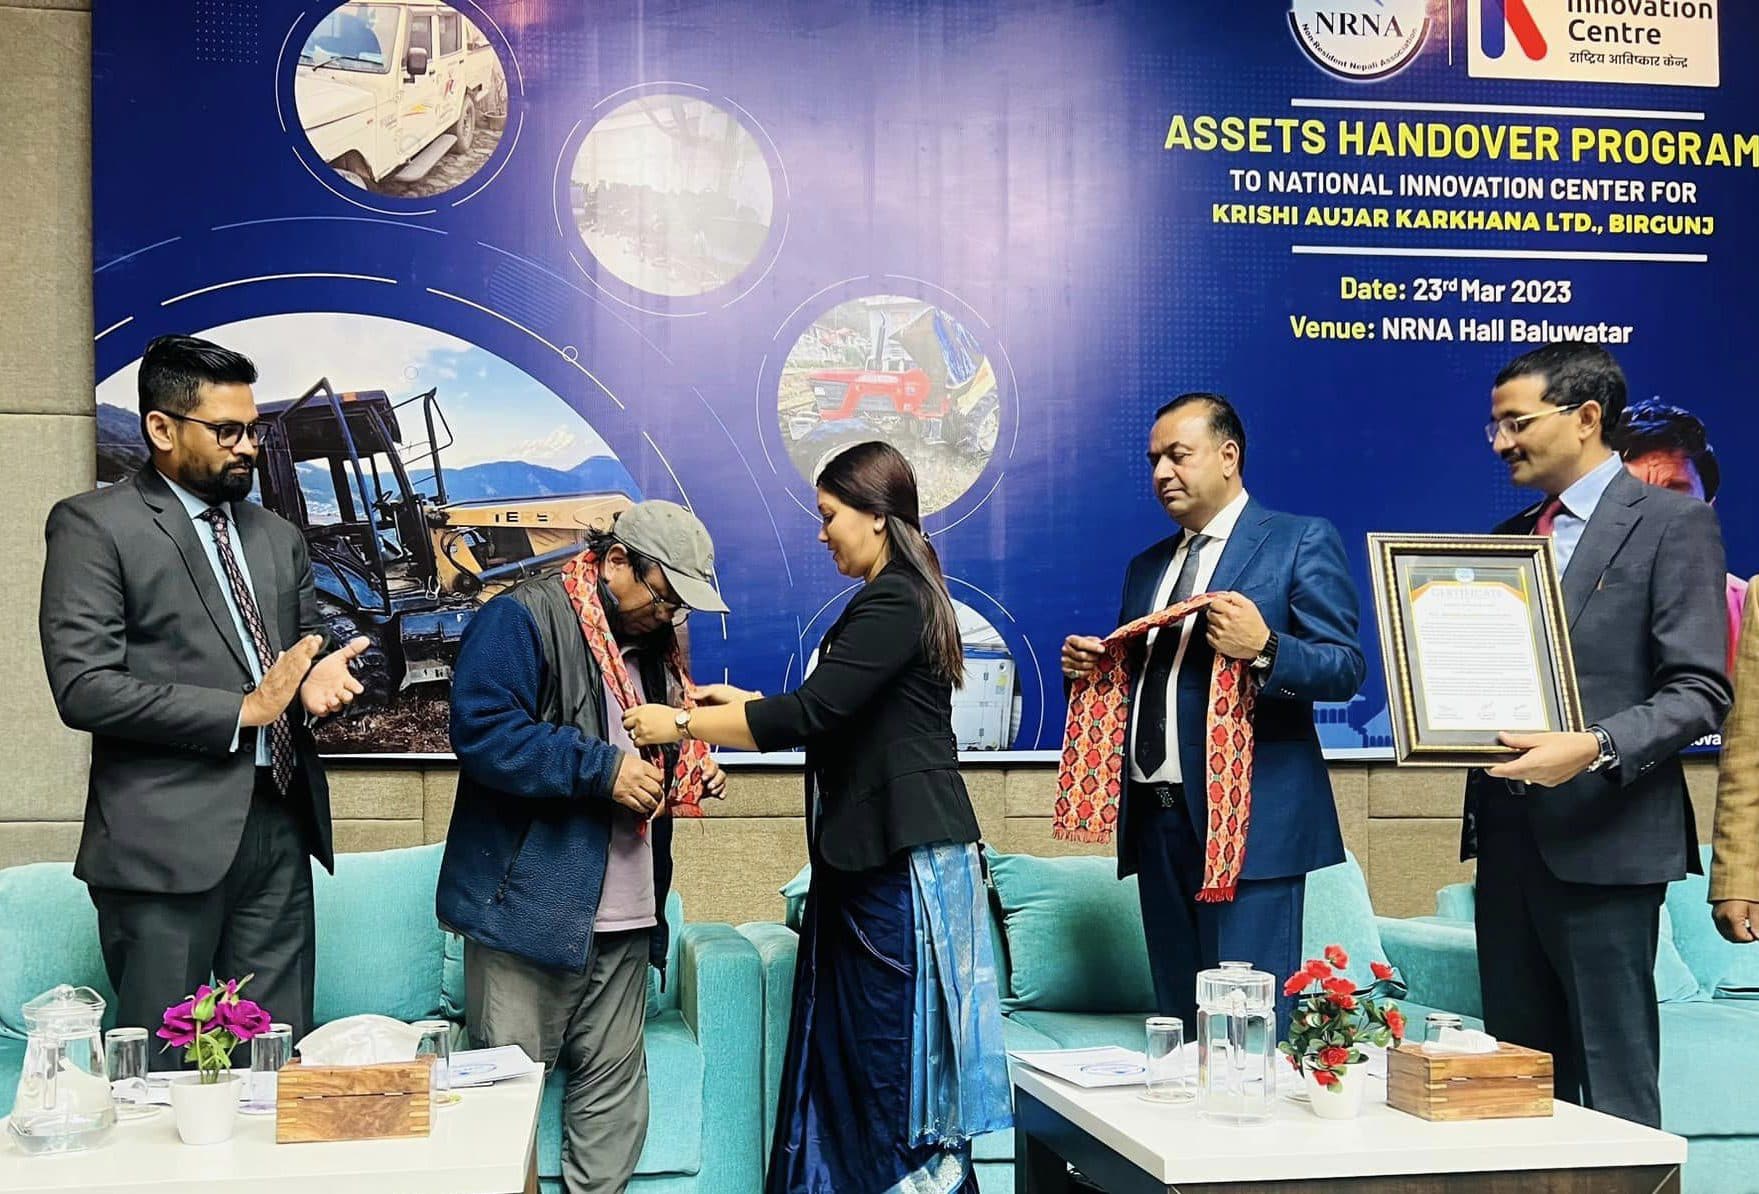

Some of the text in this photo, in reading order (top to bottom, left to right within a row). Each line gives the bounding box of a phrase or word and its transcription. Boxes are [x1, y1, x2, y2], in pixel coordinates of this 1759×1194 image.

[1315, 11, 1403, 38] NRNA
[1567, 19, 1662, 45] Centre
[1164, 114, 1759, 168] ASSETS HANDOVER PROGRAM
[1229, 169, 1697, 204] TO NATIONAL INNOVATION CENTER FOR
[1212, 203, 1714, 235] KRISHI AUJAR KARKHANA LTD., BIRGUNJ
[1341, 276, 1572, 304] Date: 23rd Mar 2023
[1289, 315, 1634, 344] Venue: NRNA Hall Baluwatar
